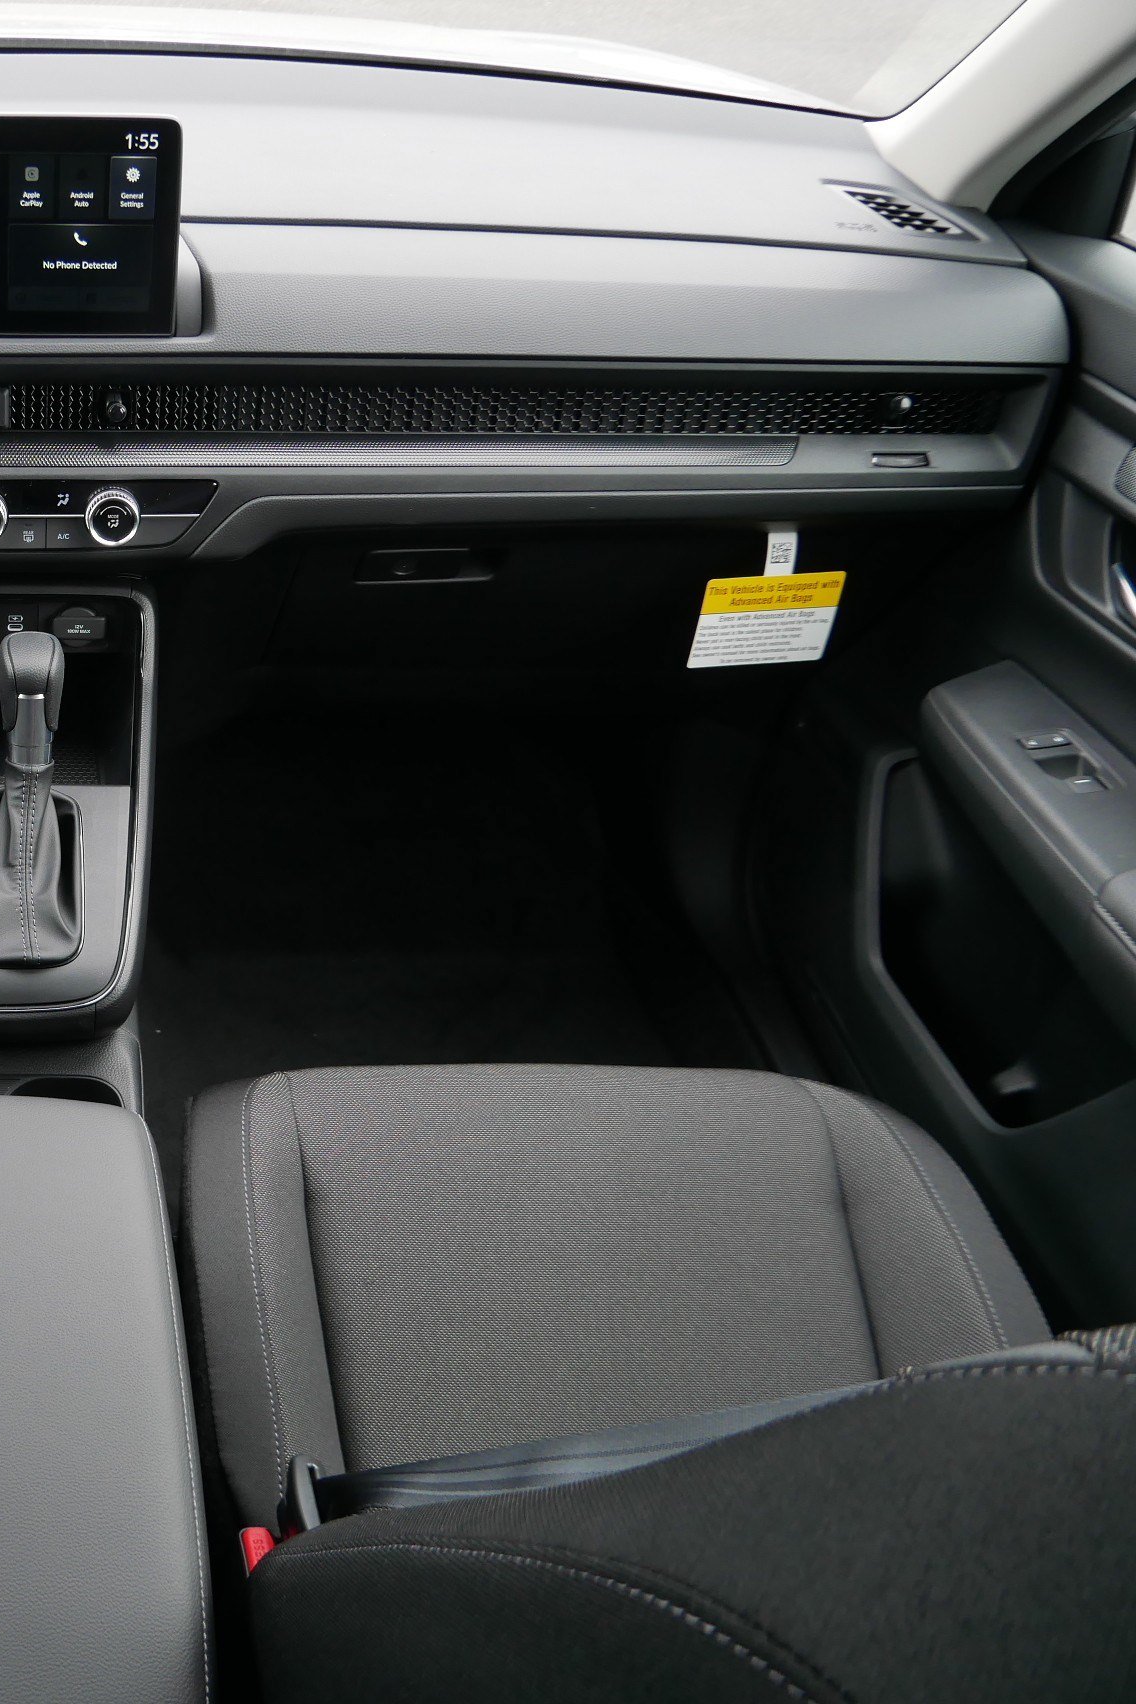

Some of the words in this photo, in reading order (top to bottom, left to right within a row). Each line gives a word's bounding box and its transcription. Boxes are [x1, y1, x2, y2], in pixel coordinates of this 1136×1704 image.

[125, 134, 159, 150] 1:55
[120, 192, 144, 200] General
[20, 200, 44, 208] CarPlay
[74, 200, 89, 208] Auto
[120, 201, 144, 209] Settings
[43, 261, 55, 269] No
[56, 261, 80, 269] Phone
[82, 261, 118, 270] Detected
[709, 586, 728, 596] This
[731, 584, 764, 594] Vehicle
[765, 584, 774, 592] is
[778, 581, 818, 592] Equipped
[821, 579, 840, 588] with
[730, 597, 773, 606] Advanced
[775, 595, 790, 603] Air
[791, 594, 813, 604] Bags
